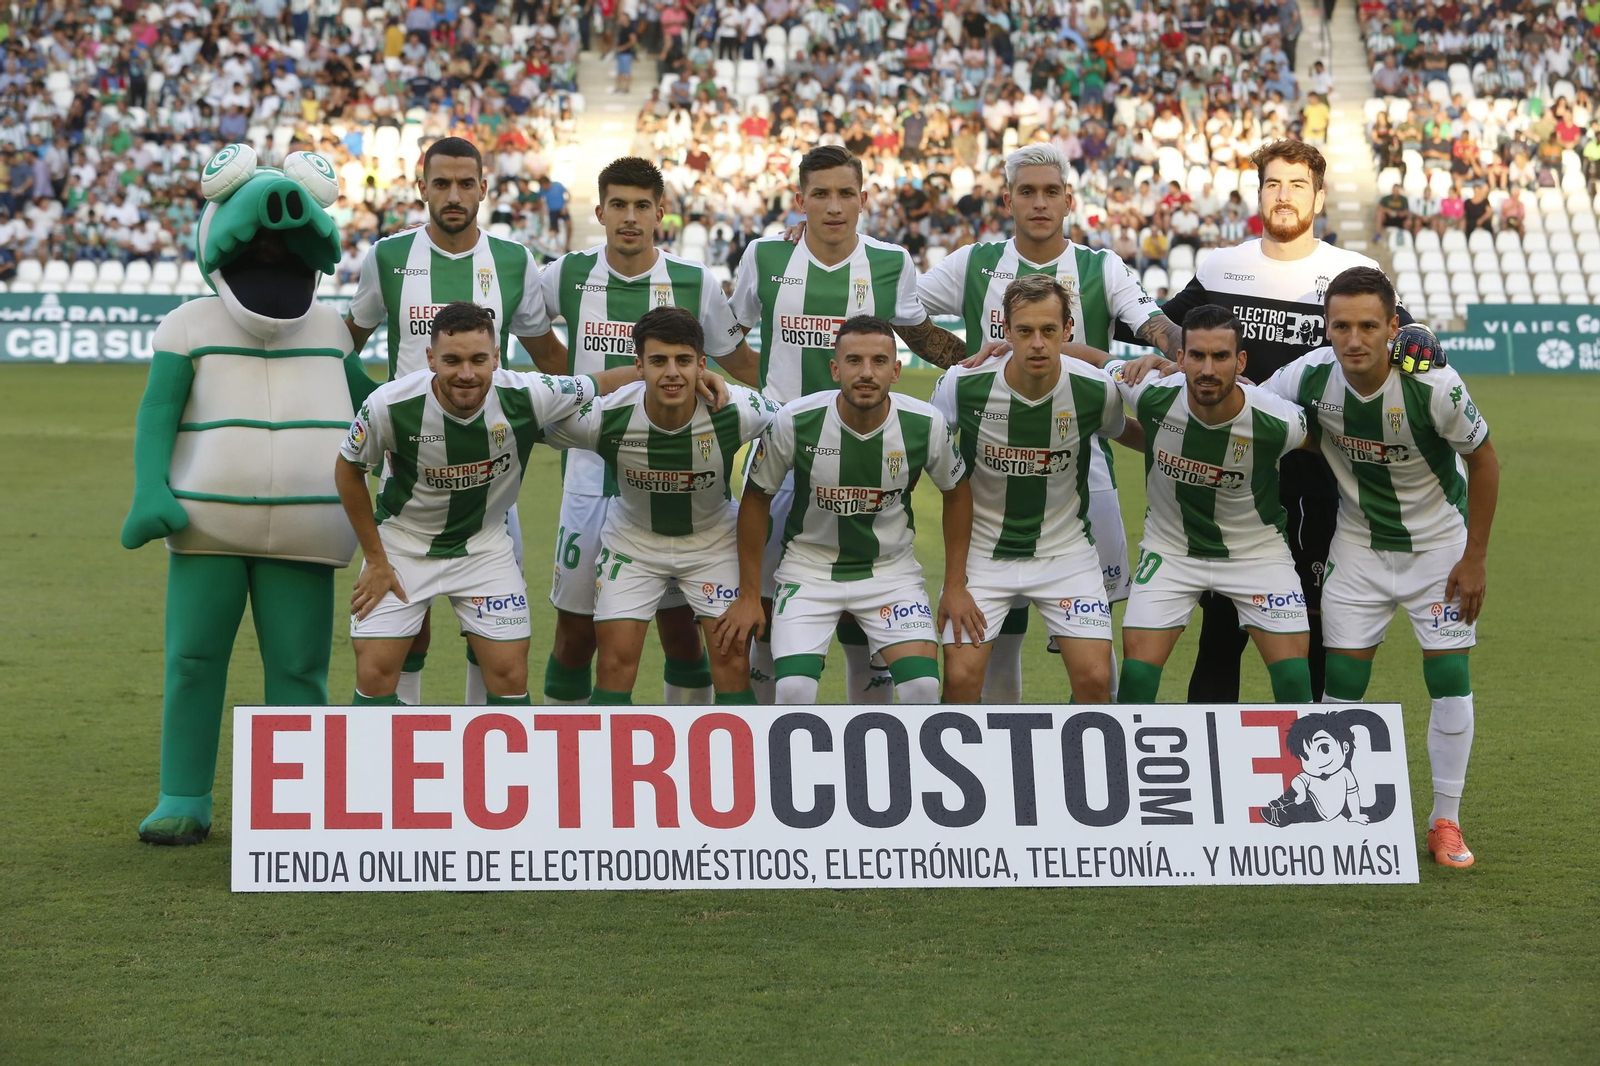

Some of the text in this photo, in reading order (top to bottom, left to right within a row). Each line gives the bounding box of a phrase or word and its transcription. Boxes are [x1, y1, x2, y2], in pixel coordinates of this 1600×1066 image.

[393, 267, 428, 276] Kappa
[981, 267, 1013, 280] Kappa
[1224, 272, 1255, 282] Kappa
[575, 283, 606, 293] Kappa
[771, 275, 803, 286] Kappa
[409, 306, 445, 319] ELEC
[1233, 306, 1286, 325] ELECTRO
[410, 320, 432, 335] COS
[585, 321, 635, 338] ELECTRO
[781, 316, 831, 331] ELECTRO
[1241, 321, 1275, 341] OSTO
[5, 321, 155, 363] cajasu
[584, 336, 626, 353] COSTO
[782, 329, 822, 346] COSTO
[1311, 399, 1343, 412] Kappa
[974, 409, 1008, 420] Kappa
[1152, 417, 1184, 434] Kappa
[409, 434, 445, 443] Kappa
[611, 438, 647, 448] Kappa
[806, 445, 841, 455] Kappa
[985, 445, 1036, 461] ELECTRO
[984, 457, 1027, 475] COSTO
[1157, 450, 1208, 475] ELECTRO
[424, 463, 478, 478] ELECTRO
[625, 469, 679, 482] ELECTRO
[1157, 459, 1198, 484] COSTO
[426, 475, 470, 489] COSTO
[626, 478, 670, 492] COSTO
[816, 486, 868, 501] ELECTRO
[817, 497, 858, 514] COSTO
[557, 525, 582, 570] 16
[486, 593, 526, 612] forte
[1073, 599, 1110, 614] forte
[893, 601, 932, 621] forte
[1271, 611, 1304, 619] Kappa
[496, 617, 528, 626] Kappa
[901, 621, 931, 629] Kappa
[1080, 617, 1110, 628] Kappa
[1440, 628, 1471, 637] Kappa
[1133, 713, 1194, 826] .COM
[249, 839, 1400, 884] TIENDA ONLINE DE ELECTRODOMÉSTICOS, ELECTRÓNICA, TELEFONÍA... Y MUCHO MÁS!
